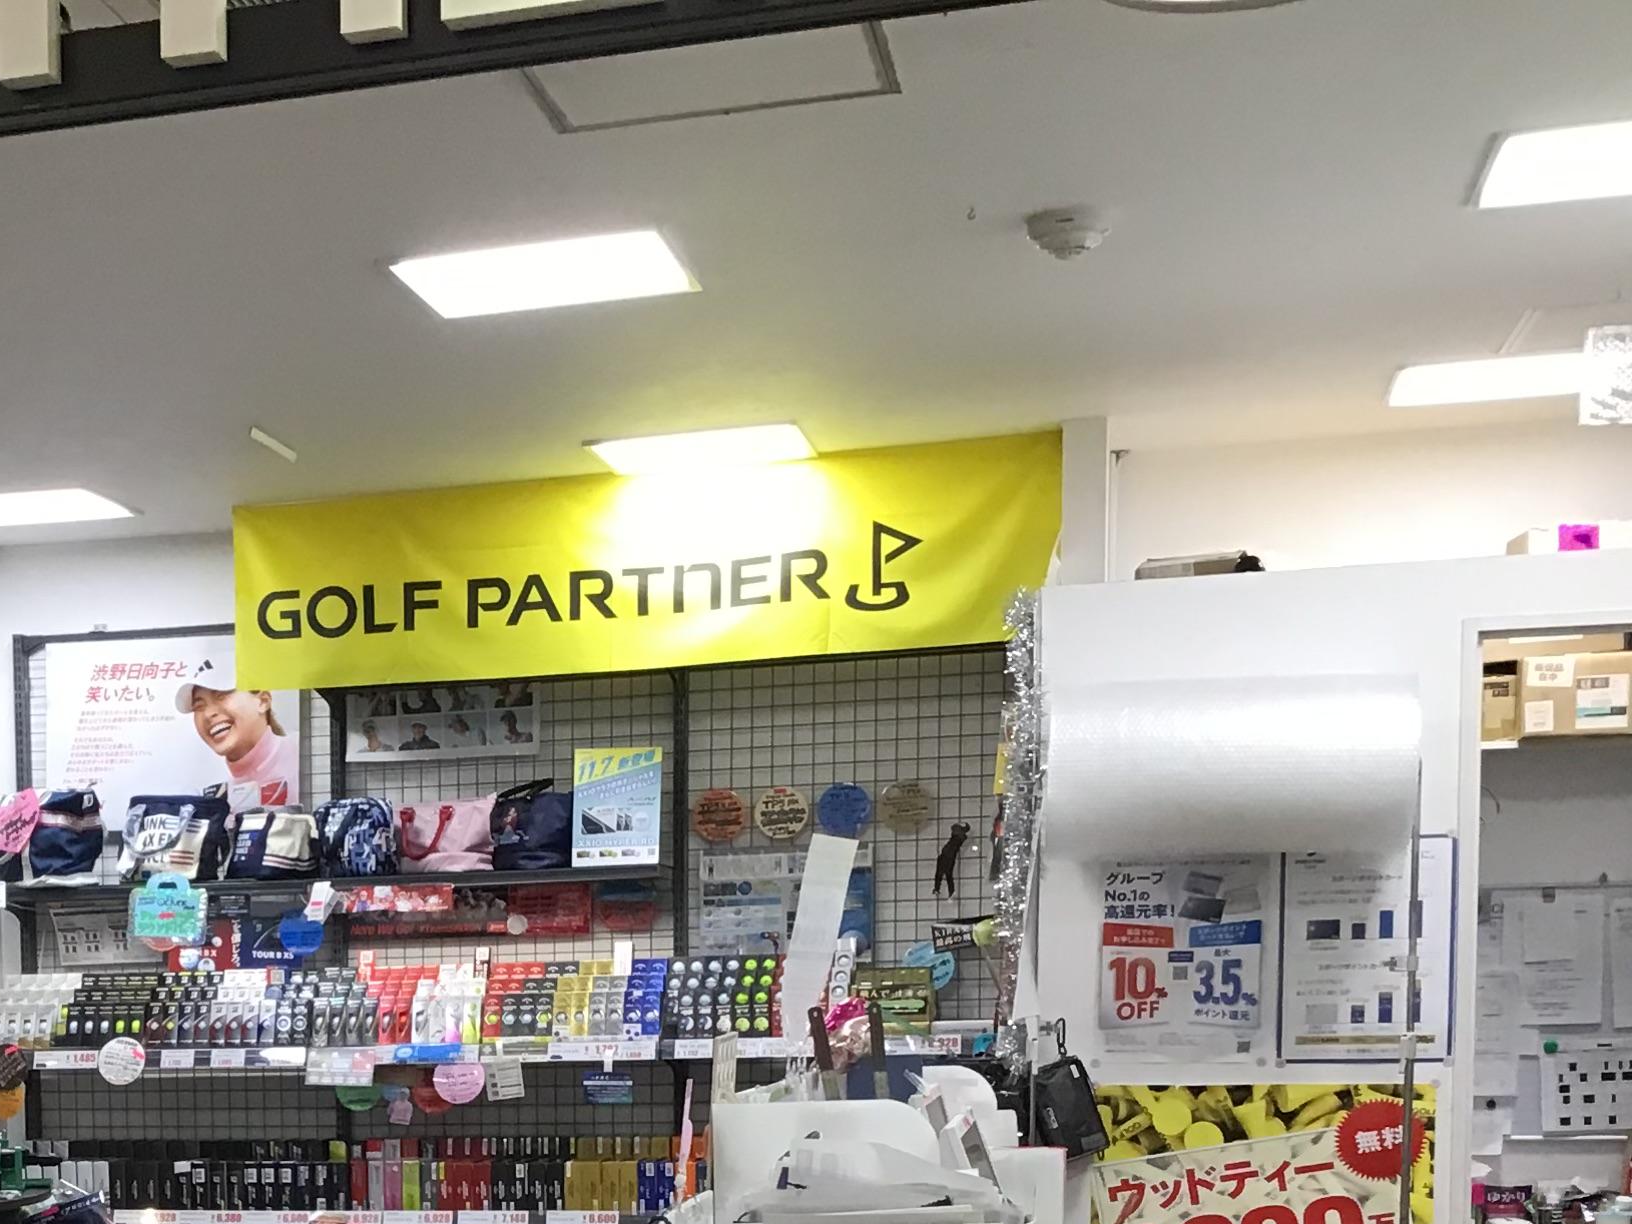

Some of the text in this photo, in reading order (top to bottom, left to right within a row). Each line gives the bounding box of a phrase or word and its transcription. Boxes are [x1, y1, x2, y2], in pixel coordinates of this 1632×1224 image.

[258, 580, 444, 641] GOLF
[1106, 872, 1166, 886] グループ
[1104, 889, 1151, 902] No.1の
[1116, 1001, 1160, 1021] OFF
